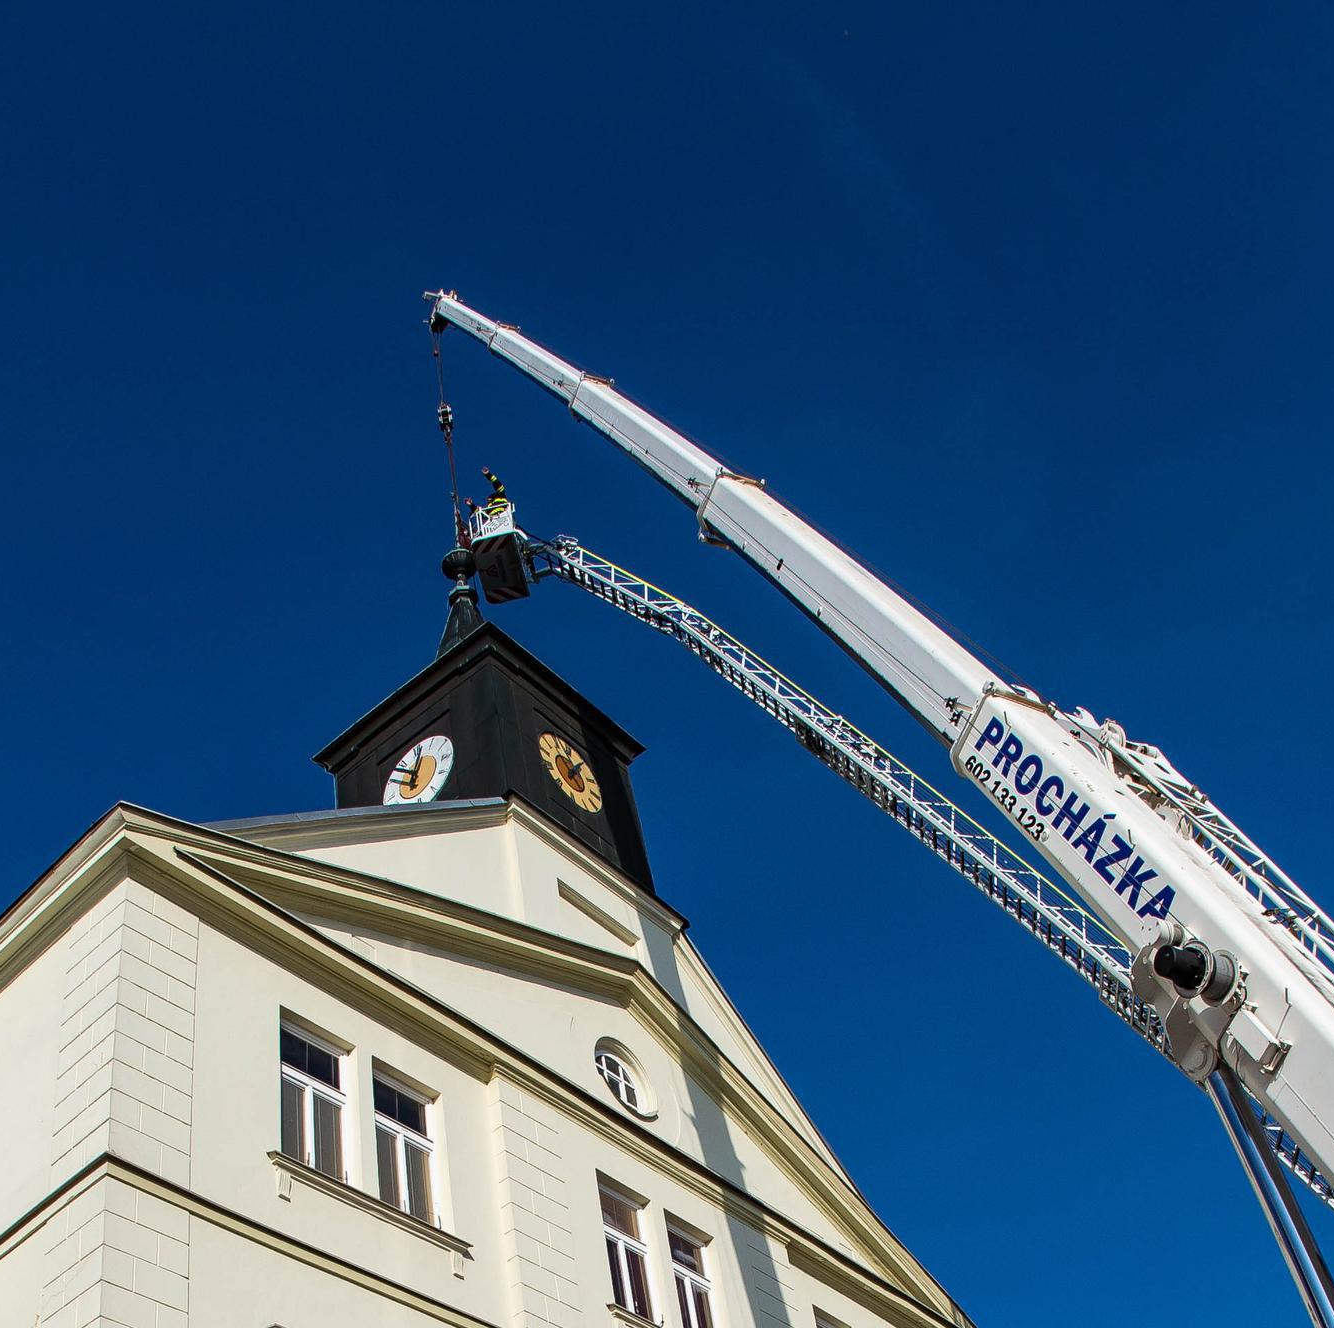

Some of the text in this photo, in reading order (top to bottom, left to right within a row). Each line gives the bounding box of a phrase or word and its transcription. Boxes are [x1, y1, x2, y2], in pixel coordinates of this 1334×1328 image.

[965, 755, 1045, 841] 602 133 123
[974, 716, 1176, 920] PROCHÁZKA
